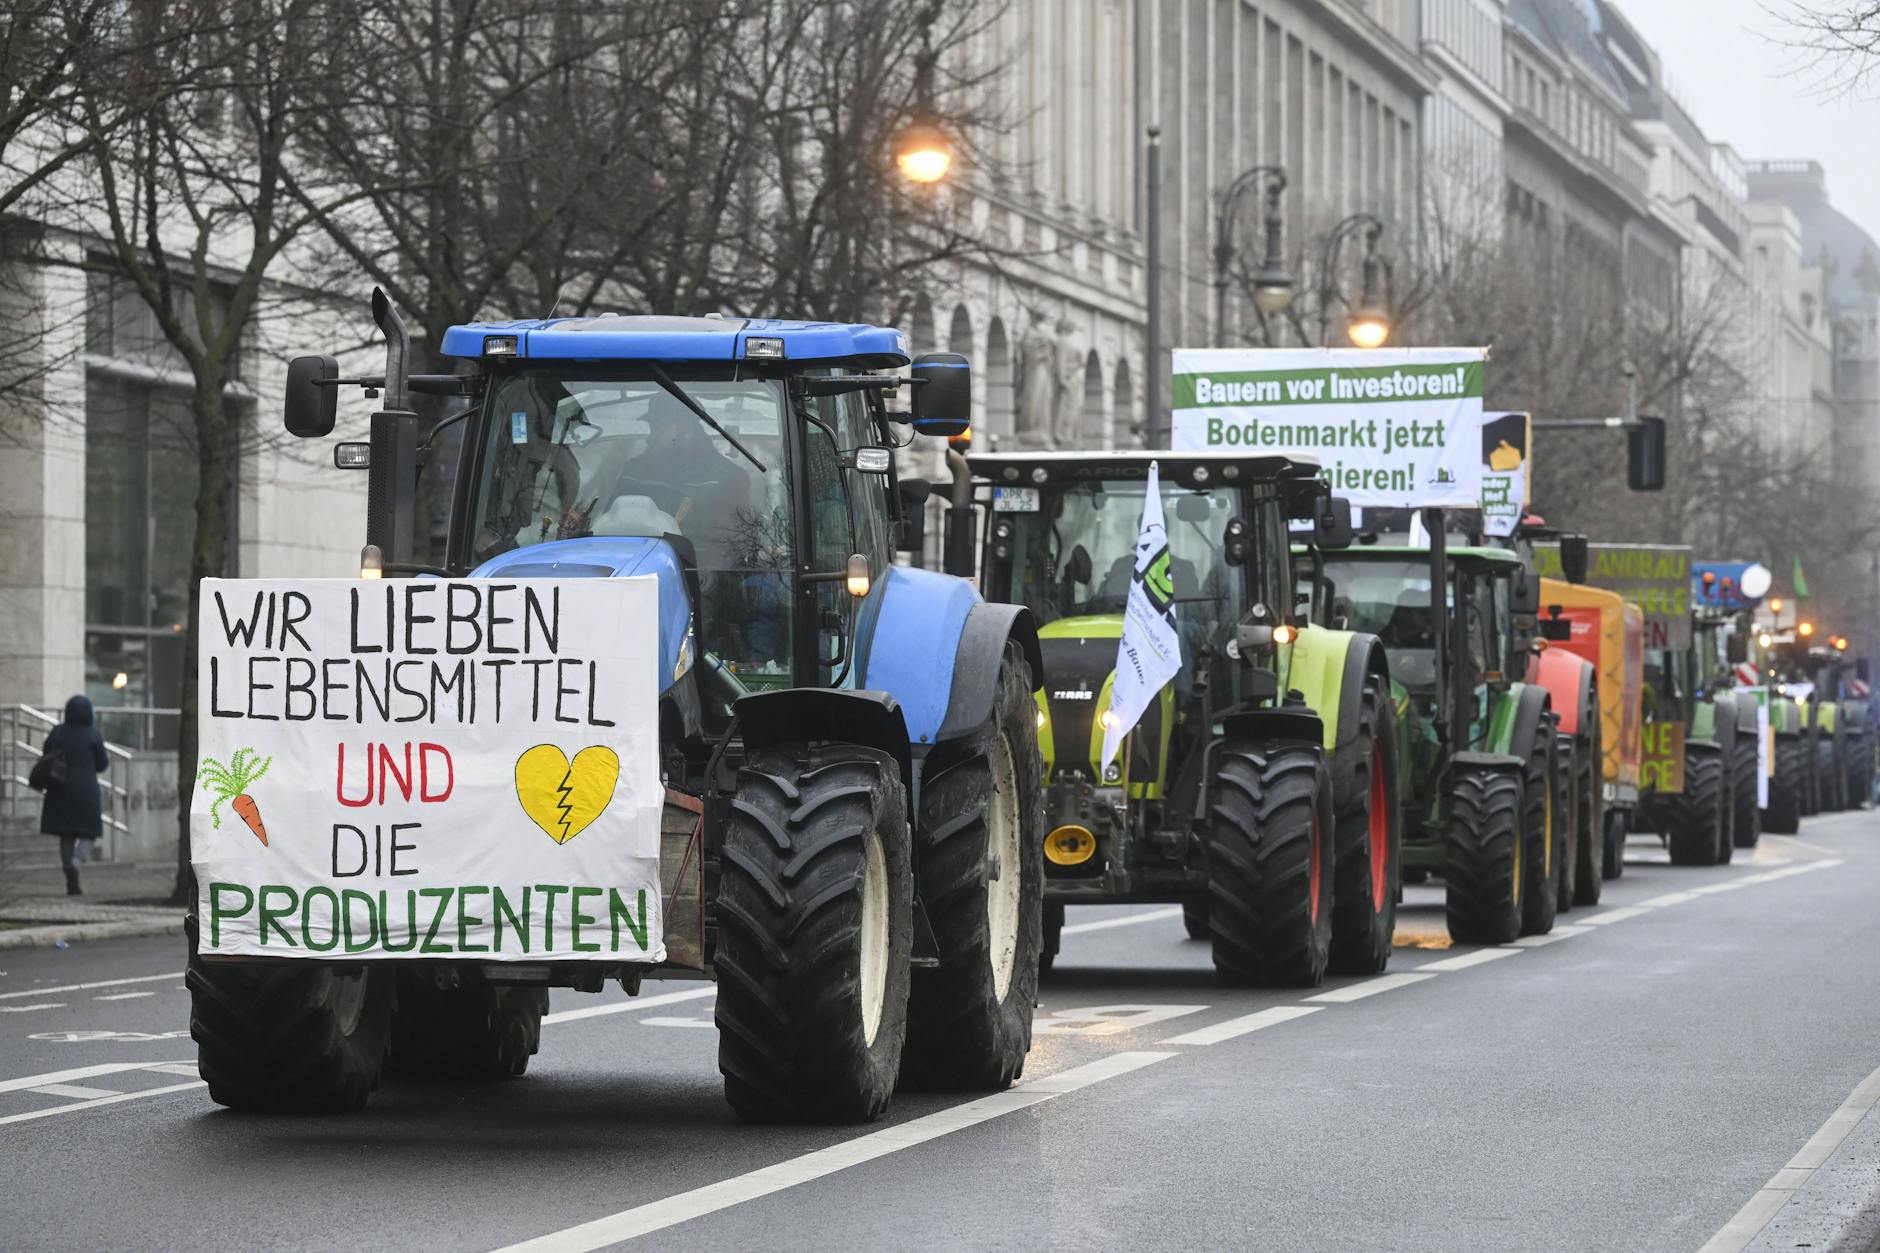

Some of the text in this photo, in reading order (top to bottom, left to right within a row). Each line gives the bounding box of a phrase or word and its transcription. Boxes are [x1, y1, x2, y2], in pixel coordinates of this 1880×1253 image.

[1195, 367, 1465, 404] Bauern vor Investoren!
[1206, 417, 1446, 454] Bodenmarkt jetzt
[1074, 467, 1162, 478] ARIO
[1315, 460, 1415, 491] mieren!
[213, 583, 561, 655] WIR LIEBEN
[210, 656, 616, 727] LEBENSMITTEL
[336, 741, 454, 807] UND
[332, 823, 421, 877] DIE
[209, 882, 648, 953] PRODUZENTEN
